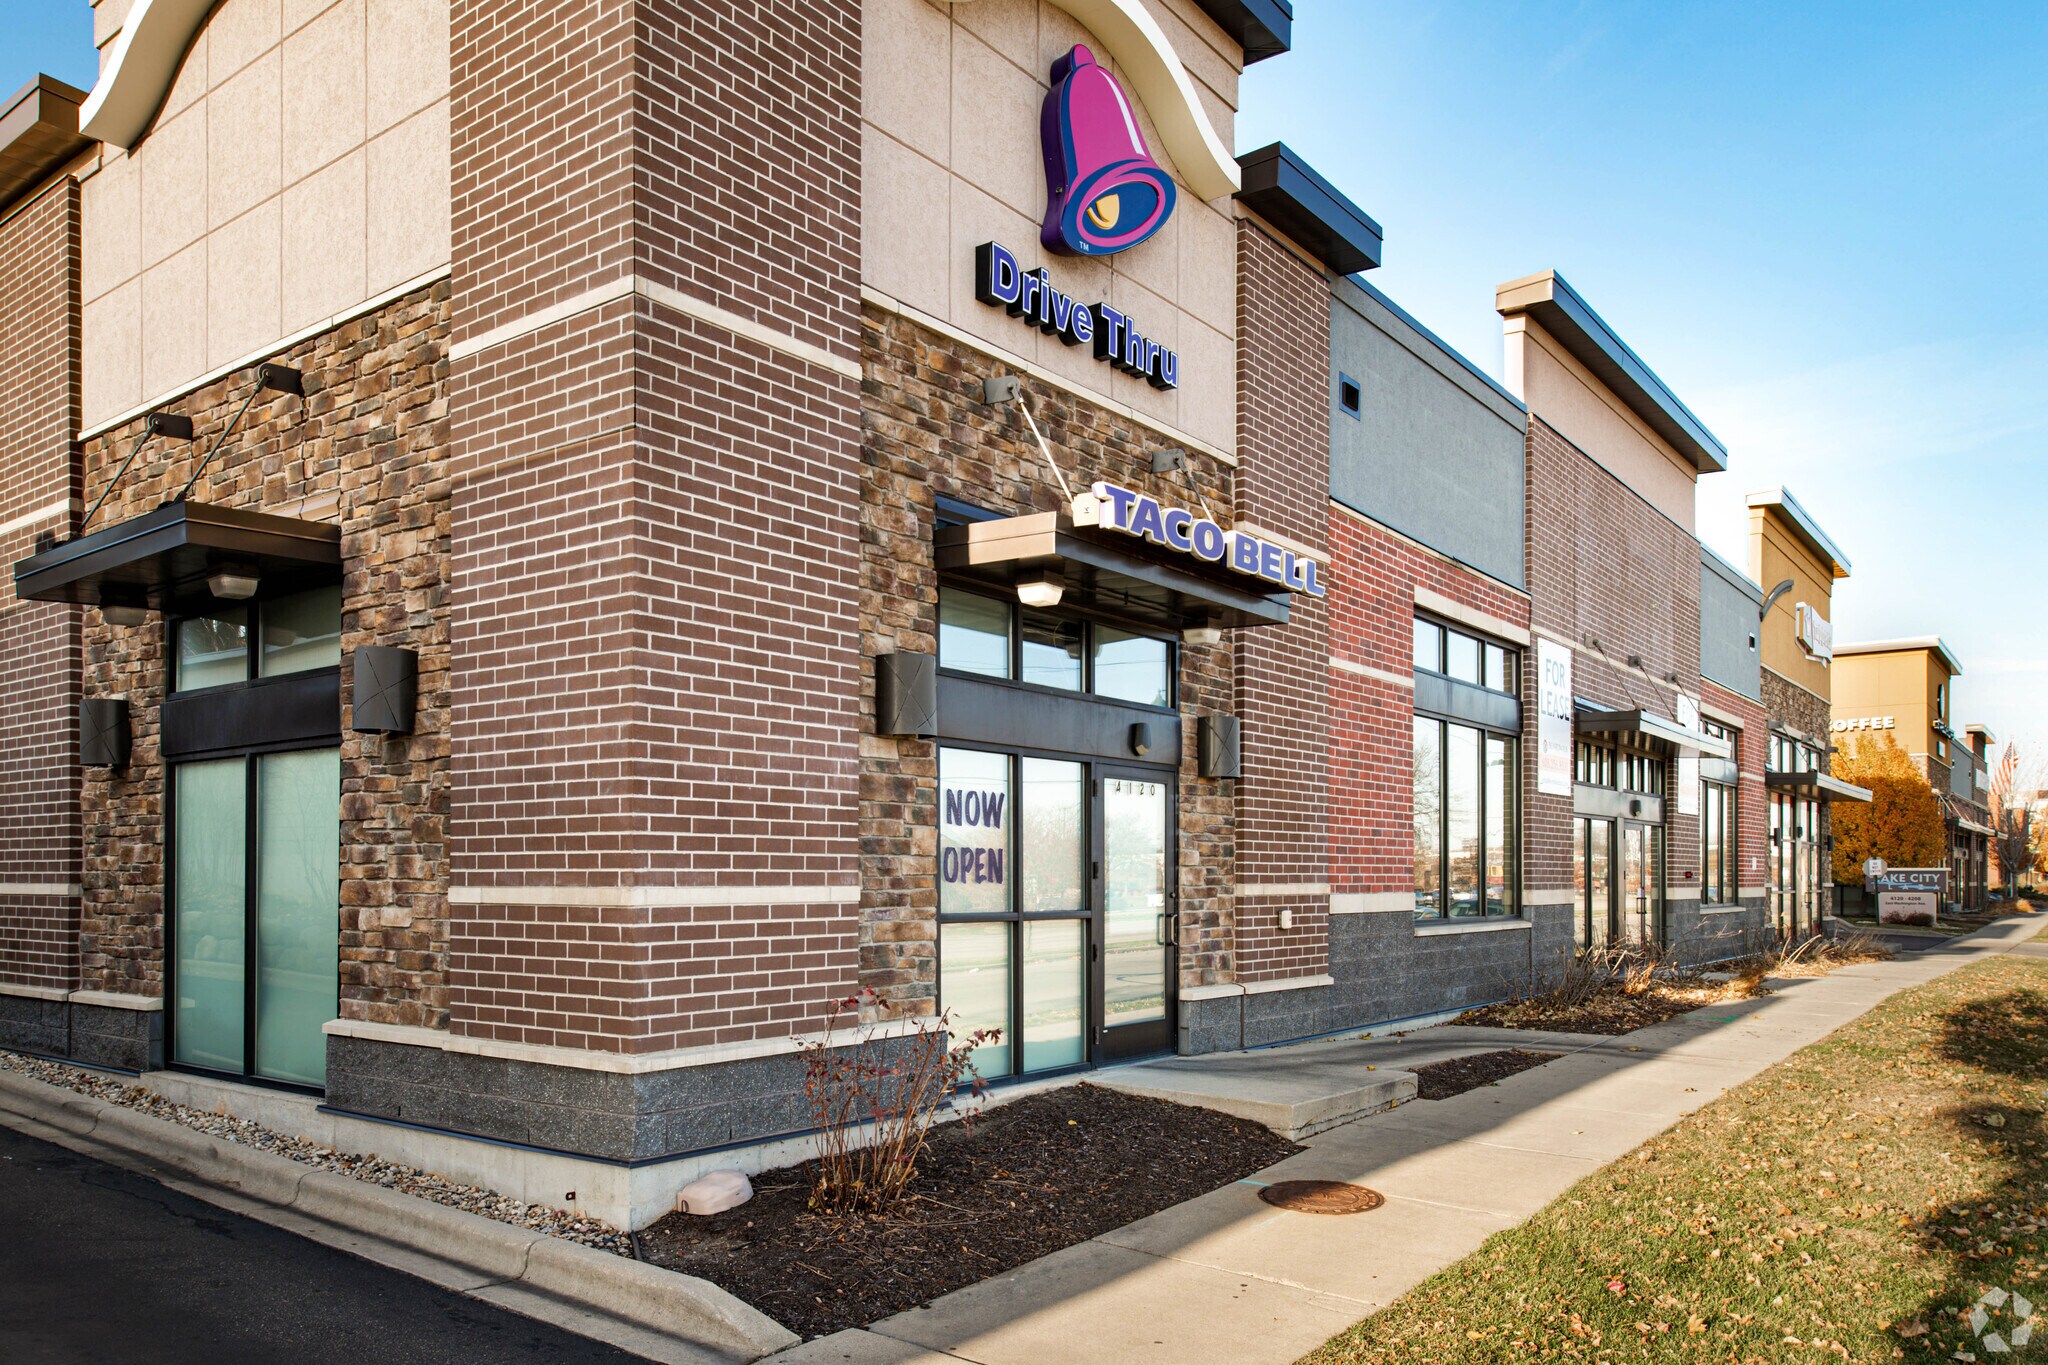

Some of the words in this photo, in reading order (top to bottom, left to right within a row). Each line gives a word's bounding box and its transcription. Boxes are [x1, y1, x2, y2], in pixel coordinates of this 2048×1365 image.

[1079, 240, 1089, 252] TM
[989, 240, 1094, 346] Drive
[1099, 302, 1180, 390] Thru
[1098, 481, 1226, 562] TACO
[1231, 531, 1327, 599] BELL
[1545, 657, 1566, 689] FOR
[1540, 688, 1570, 722] LEASE
[1115, 780, 1156, 796] 4120
[945, 788, 1005, 829] NOW
[943, 846, 1003, 884] OPEN
[1877, 873, 1906, 883] AKE
[1909, 873, 1940, 883] CITY
